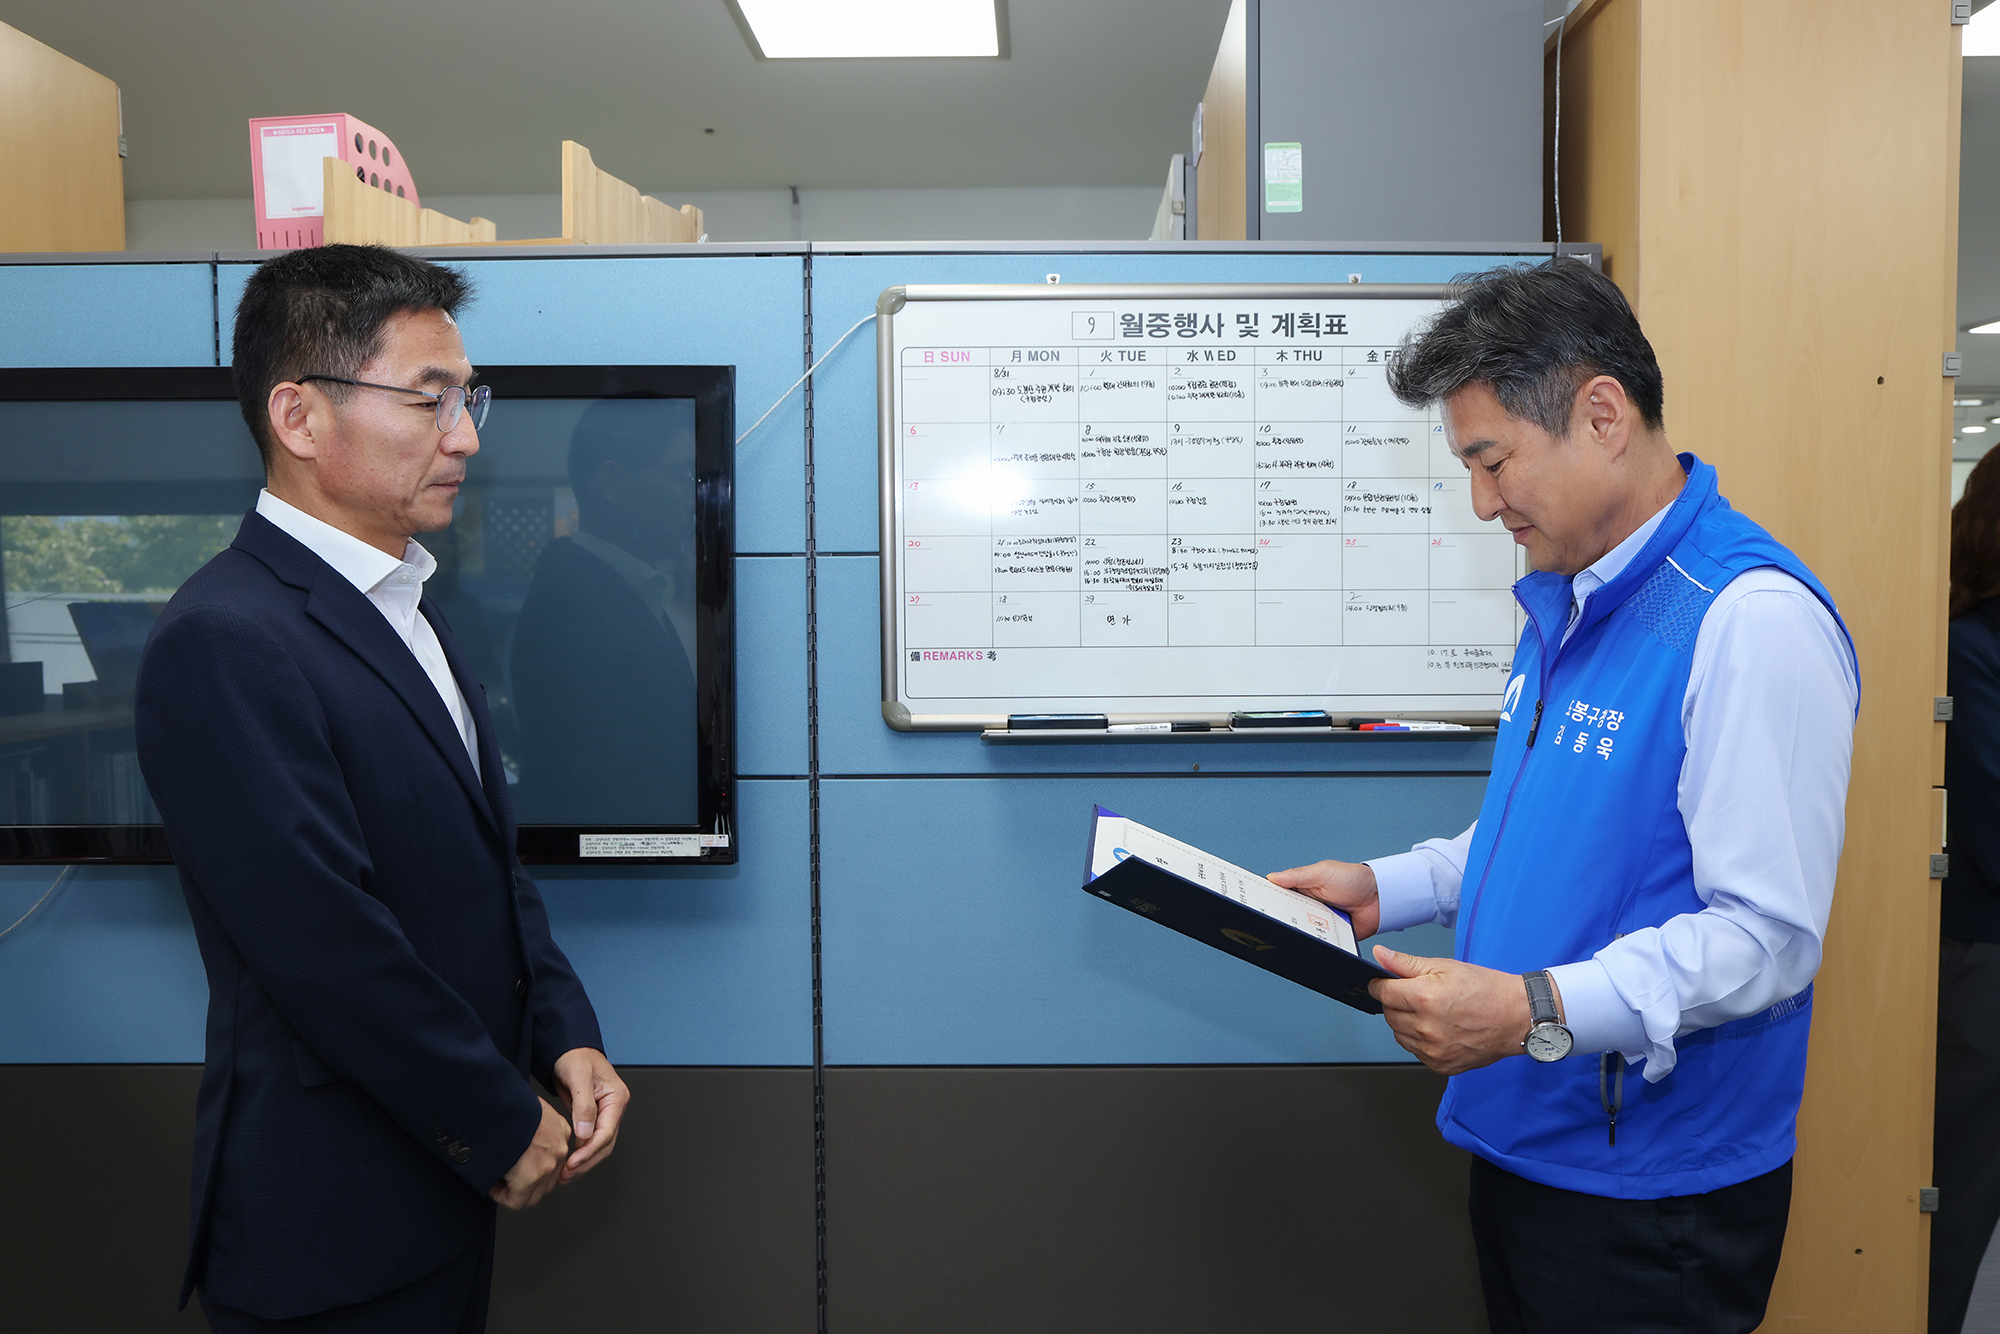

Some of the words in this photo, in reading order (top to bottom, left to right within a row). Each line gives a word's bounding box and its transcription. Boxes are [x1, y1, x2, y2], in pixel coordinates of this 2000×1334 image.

[1087, 316, 1096, 335] 9
[1119, 312, 1225, 338] 월중행사
[1235, 312, 1260, 338] 및
[1271, 312, 1348, 338] 계획표
[924, 351, 934, 363] 日
[940, 351, 970, 363] SUN
[1011, 350, 1022, 363] 月
[1028, 350, 1060, 362] MON
[1100, 350, 1113, 362] 火
[1118, 350, 1147, 362] TUE
[1186, 350, 1199, 362] 水
[1276, 350, 1288, 362] 木
[1293, 350, 1323, 361] THU
[1366, 350, 1379, 362] 金
[993, 367, 1010, 378] 8/31
[1174, 367, 1182, 376] 2
[1261, 368, 1268, 377] 3
[992, 387, 1015, 396] 09:30
[910, 425, 917, 435] 6
[1085, 425, 1092, 435] 8
[1174, 423, 1181, 432] 9
[1259, 424, 1272, 433] 10
[1347, 425, 1357, 433] 11
[909, 482, 919, 491] 13
[1085, 482, 1096, 490] 15
[1172, 482, 1183, 491] 16
[1259, 480, 1271, 489] 17
[1347, 481, 1357, 489] 18
[1434, 482, 1443, 490] 19
[1084, 538, 1096, 546] 22
[1171, 538, 1182, 546] 23
[1258, 538, 1270, 546] 24
[1345, 538, 1357, 546] 25
[1431, 538, 1442, 546] 26
[909, 595, 921, 604] 27
[1084, 595, 1095, 603] 29
[923, 651, 983, 661] REMARKS
